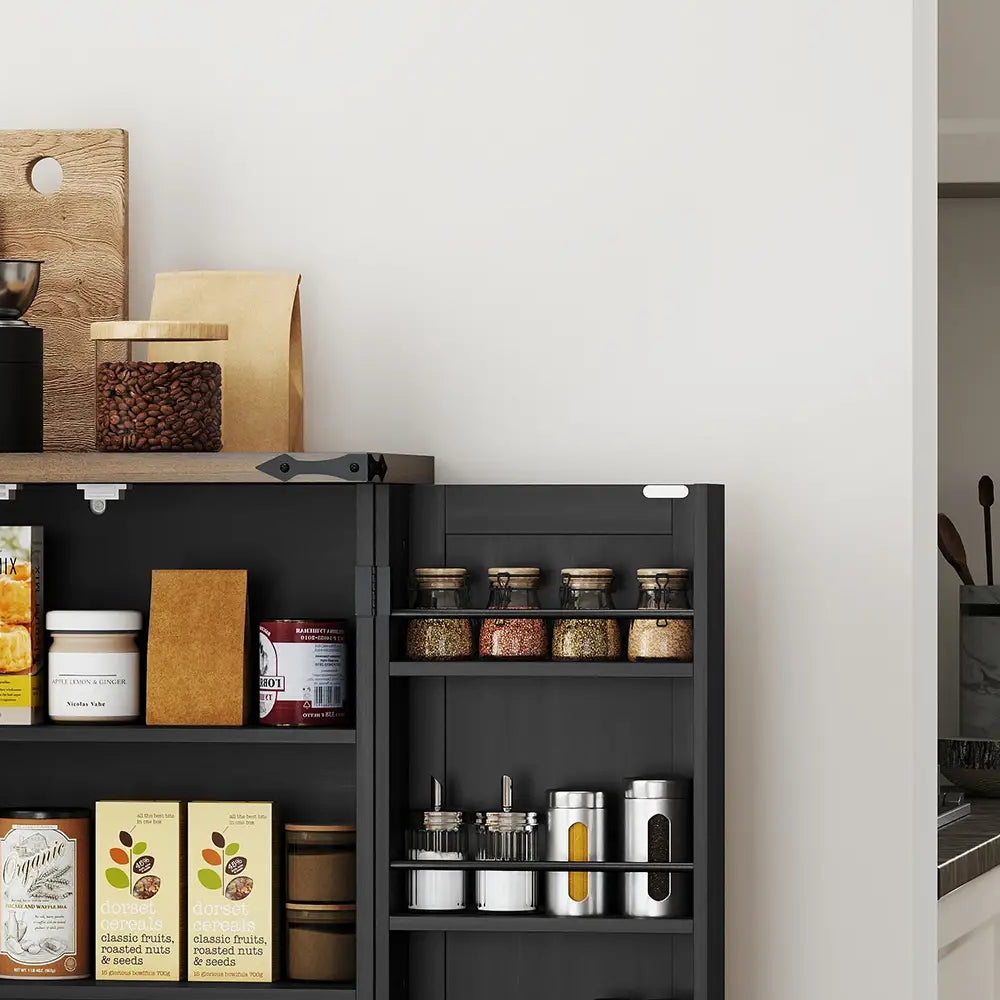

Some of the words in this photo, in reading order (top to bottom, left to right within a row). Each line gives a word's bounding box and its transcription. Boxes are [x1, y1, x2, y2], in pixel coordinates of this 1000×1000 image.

[3, 841, 64, 885] Organic
[101, 900, 156, 914] dorset
[193, 901, 248, 915] dorset
[101, 917, 162, 931] cereals
[193, 918, 255, 932] cereals
[101, 933, 138, 942] classic
[141, 934, 174, 944] fruits,
[193, 935, 230, 944] classic
[234, 935, 267, 945] fruits,
[101, 945, 141, 953] roasted
[145, 946, 170, 954] nuts
[193, 946, 234, 955] roasted
[238, 947, 263, 955] nuts
[101, 956, 110, 964] &
[113, 956, 143, 965] seeds
[194, 957, 202, 966] &
[206, 957, 236, 966] seeds
